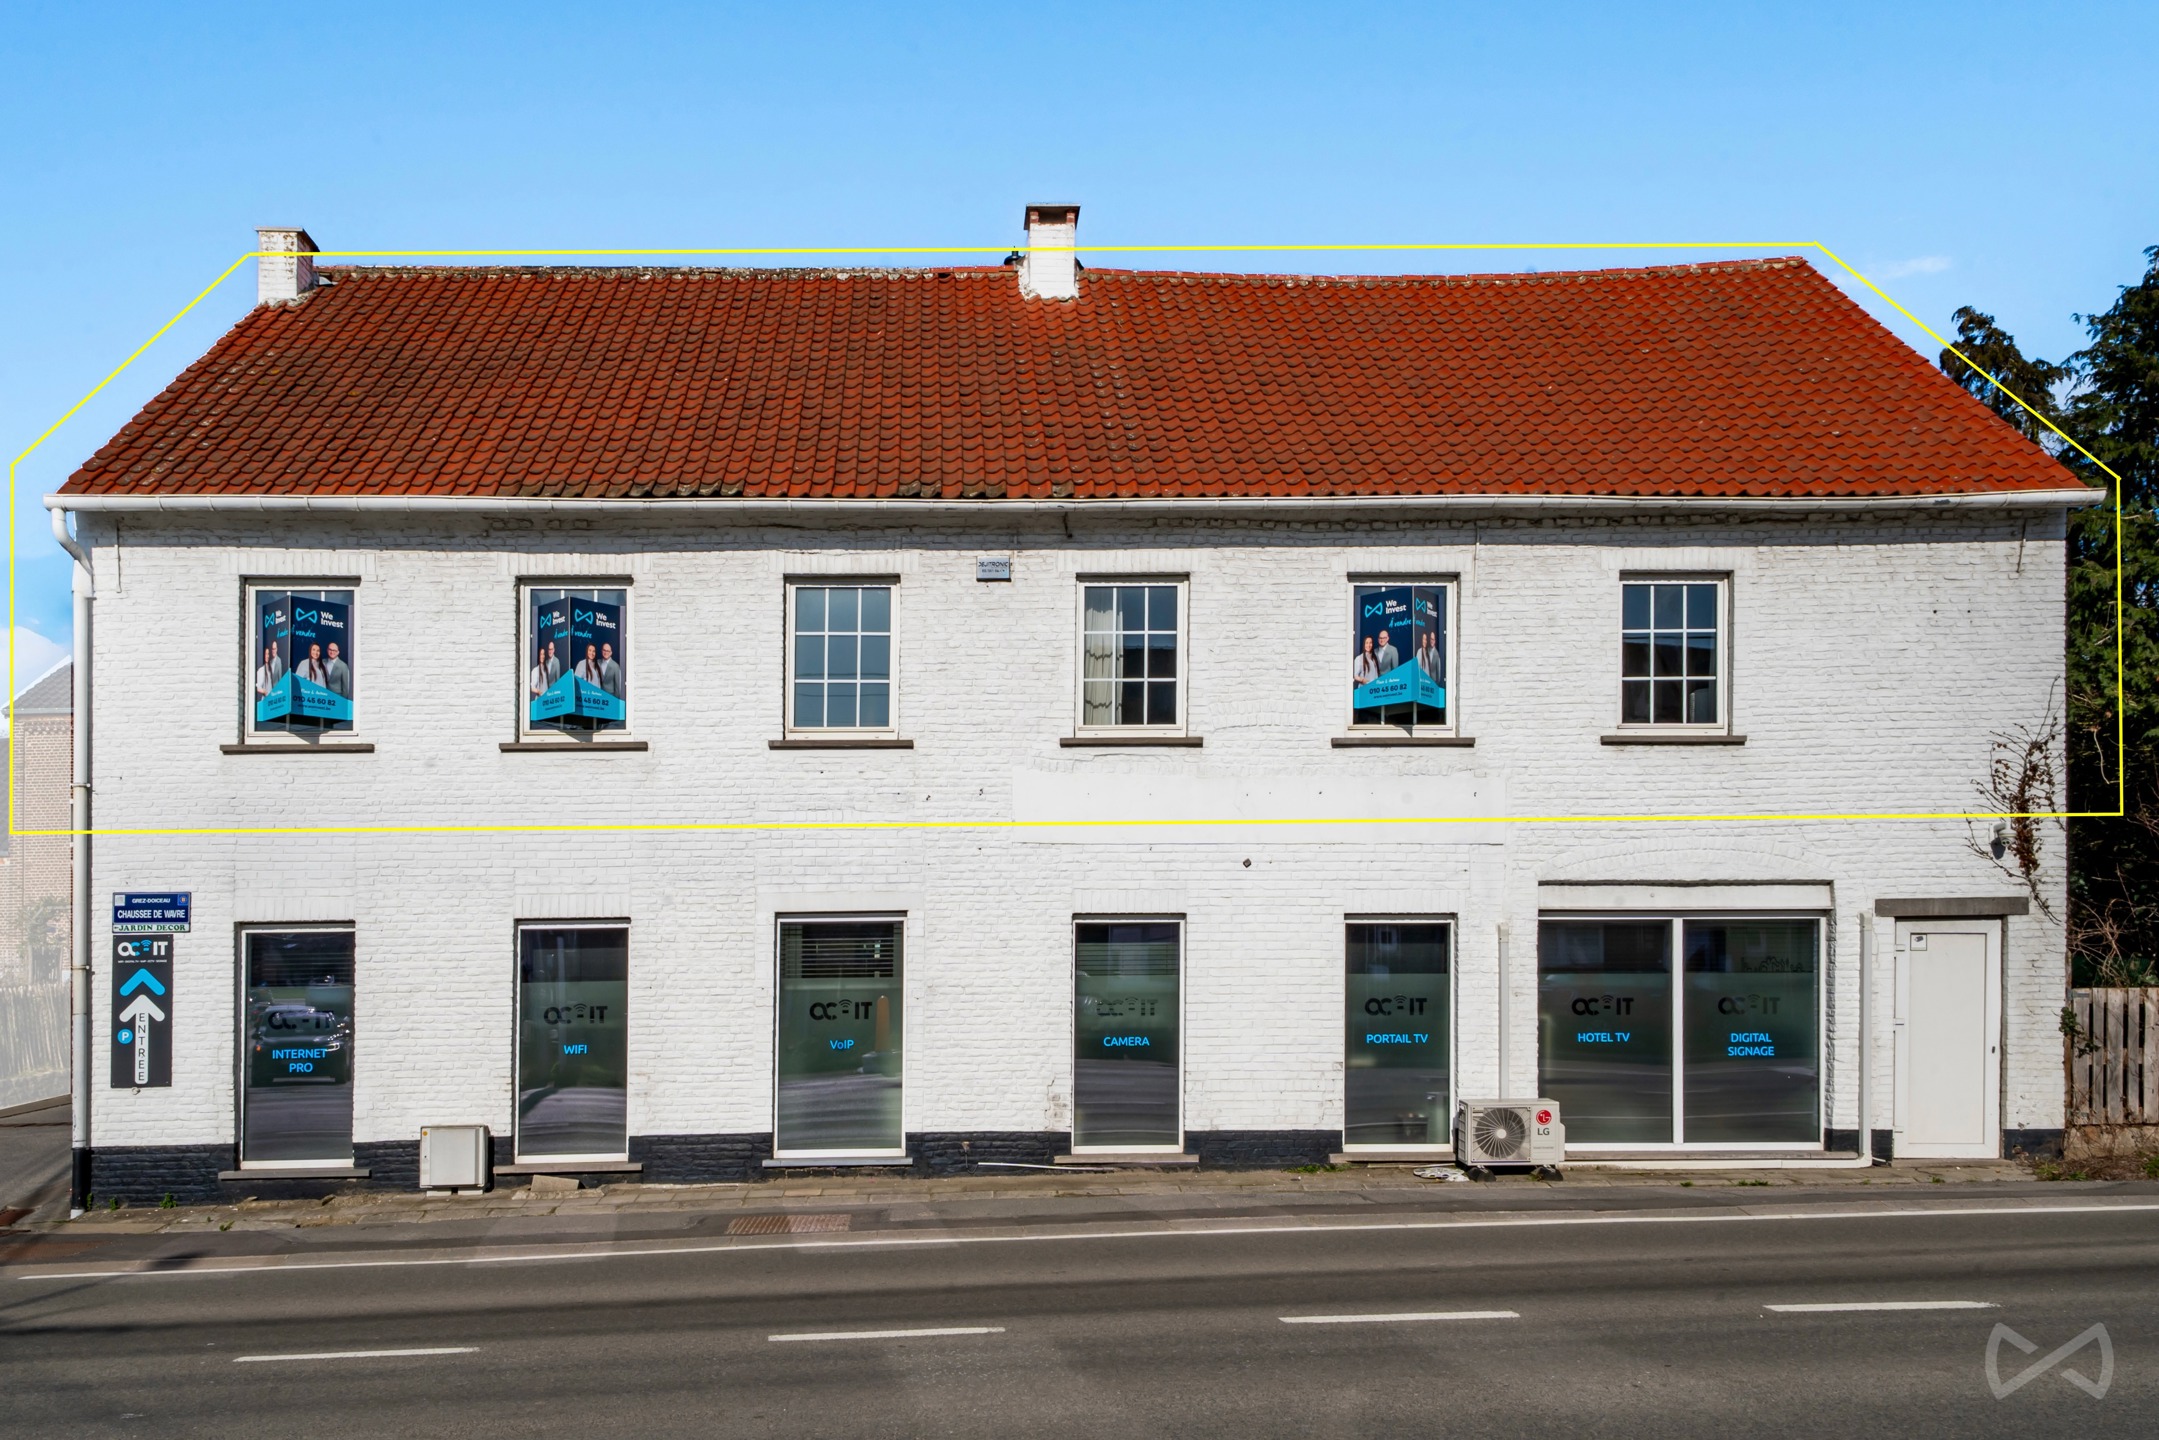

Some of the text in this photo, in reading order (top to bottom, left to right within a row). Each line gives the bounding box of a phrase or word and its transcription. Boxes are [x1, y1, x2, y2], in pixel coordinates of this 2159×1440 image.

[1385, 599, 1397, 607] We
[1385, 604, 1407, 614] Invest
[320, 611, 333, 620] We
[595, 612, 607, 621] We
[320, 618, 344, 629] Invest
[596, 619, 616, 629] Invest
[117, 909, 186, 919] CHAUSSEE DE WAVRE
[121, 1031, 129, 1041] P
[1366, 1033, 1429, 1044] PORTAIL TV
[1577, 1032, 1631, 1043] HOTEL TV
[1730, 1033, 1772, 1043] DIGITAL
[829, 1039, 855, 1050] VoIP
[1103, 1036, 1150, 1047] CAMERA
[272, 1048, 327, 1059] INTERNET
[563, 1044, 588, 1055] WIFI
[1727, 1046, 1775, 1056] SIGNAGE
[289, 1062, 314, 1072] PRO
[1537, 1127, 1550, 1136] LG
